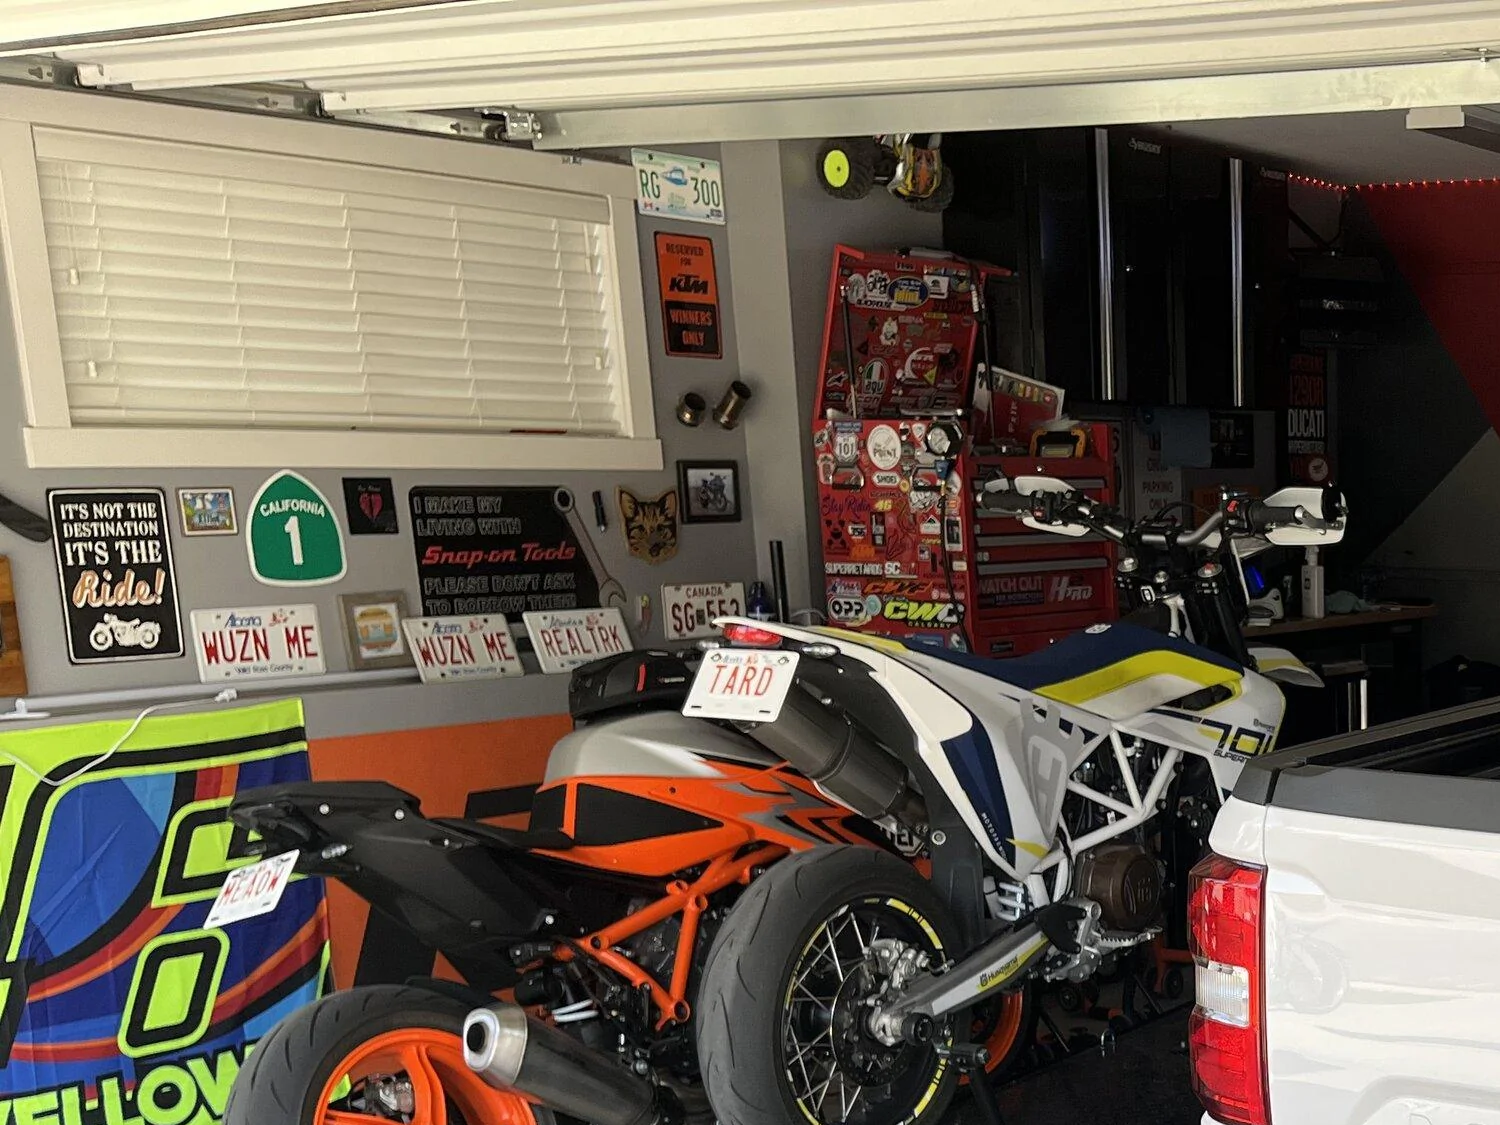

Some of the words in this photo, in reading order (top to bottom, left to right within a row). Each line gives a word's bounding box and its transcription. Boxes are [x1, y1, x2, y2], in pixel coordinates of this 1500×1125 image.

[640, 169, 661, 199] RG
[690, 177, 721, 207] 300
[669, 274, 709, 294] KTM
[670, 309, 712, 326] WINNERS
[682, 330, 705, 346] ONLY
[1288, 408, 1325, 438] DUCATI
[61, 503, 90, 521] IT'S
[93, 502, 124, 519] NOT
[126, 501, 157, 518] THE
[259, 498, 326, 519] CALIFORNIA
[424, 496, 476, 515] MAKE
[476, 496, 503, 514] MY
[63, 521, 159, 539] DESTINATION
[415, 517, 477, 537] LIVING
[477, 516, 522, 536] WITH
[64, 541, 109, 567] IT'S
[115, 540, 163, 564] THE
[284, 515, 304, 567] 1
[422, 545, 517, 570] Snap-on
[521, 540, 577, 562] Tools
[72, 567, 166, 608] Ride!
[423, 575, 490, 596] PLEASE
[491, 573, 541, 594] DON'T
[543, 571, 577, 591] ASK
[685, 585, 723, 599] CANADA
[425, 598, 452, 616] TO
[671, 601, 695, 633] SG
[202, 629, 270, 665] WUZN
[285, 625, 319, 659] ME
[415, 634, 476, 667] WUZN
[482, 632, 516, 662] ME
[540, 625, 625, 658] REALTRK
[709, 663, 773, 696] TARD
